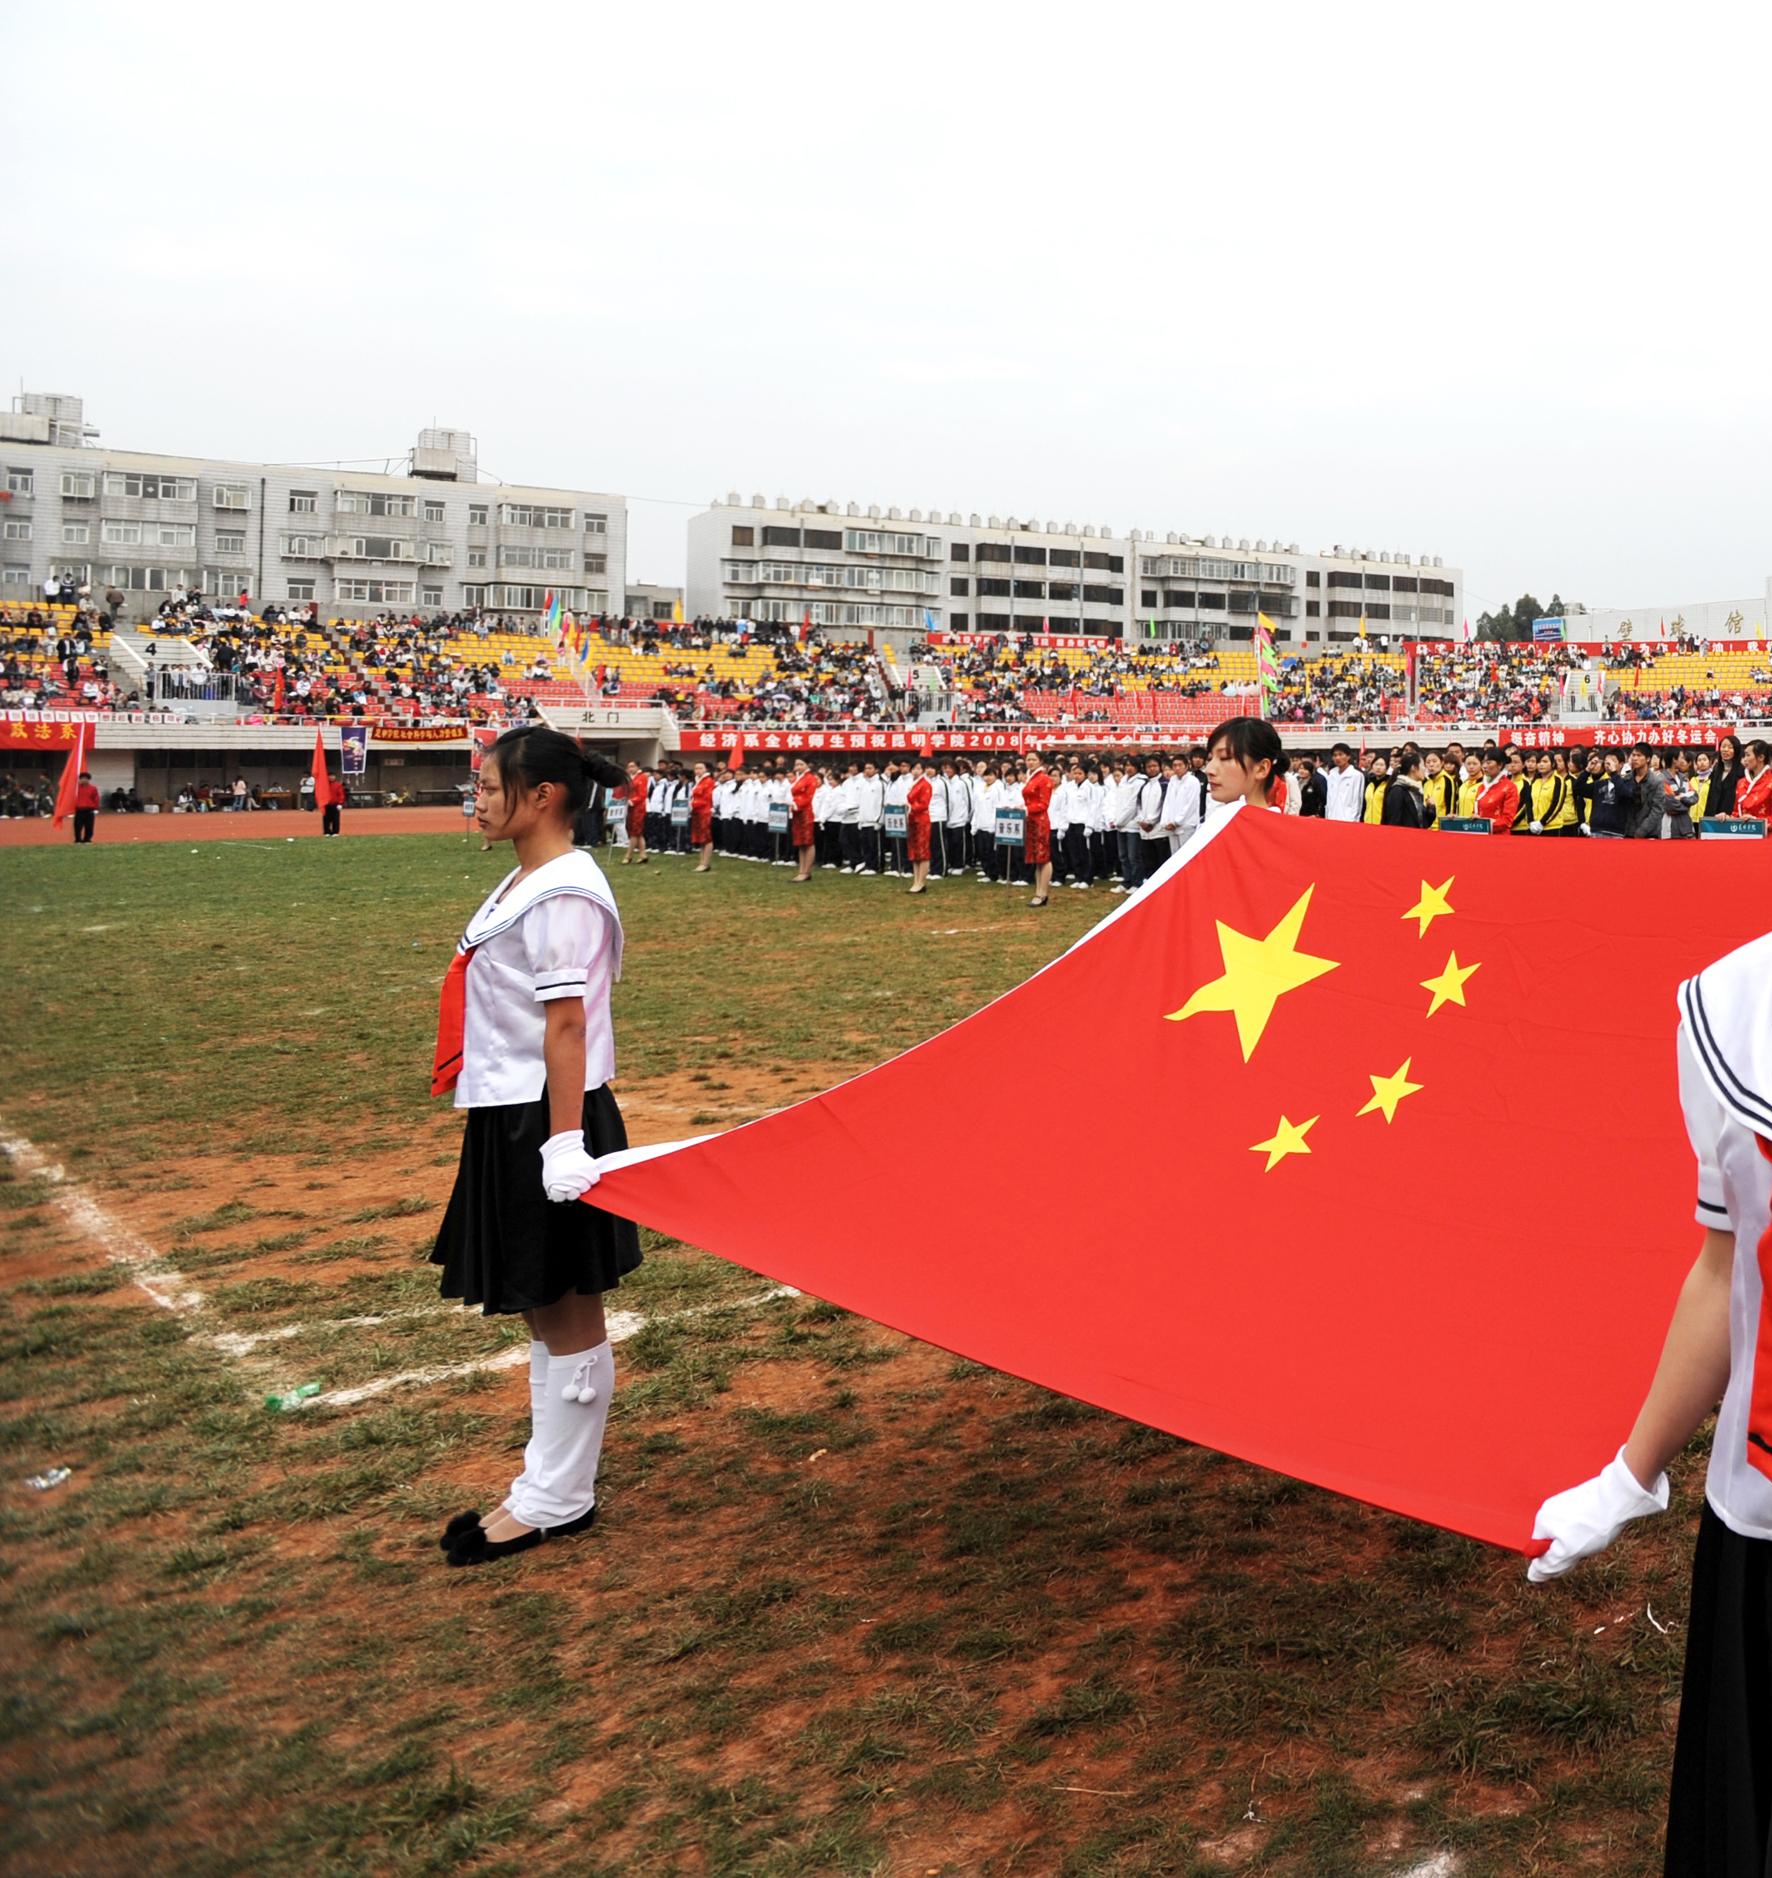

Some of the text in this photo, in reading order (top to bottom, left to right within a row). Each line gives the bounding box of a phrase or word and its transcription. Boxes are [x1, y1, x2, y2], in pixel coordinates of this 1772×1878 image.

[145, 643, 157, 656] 4
[912, 669, 920, 679] 5
[1584, 675, 1591, 684] 6
[582, 711, 619, 723] 北门
[1594, 729, 1717, 745] 齐心协力办好冬运会
